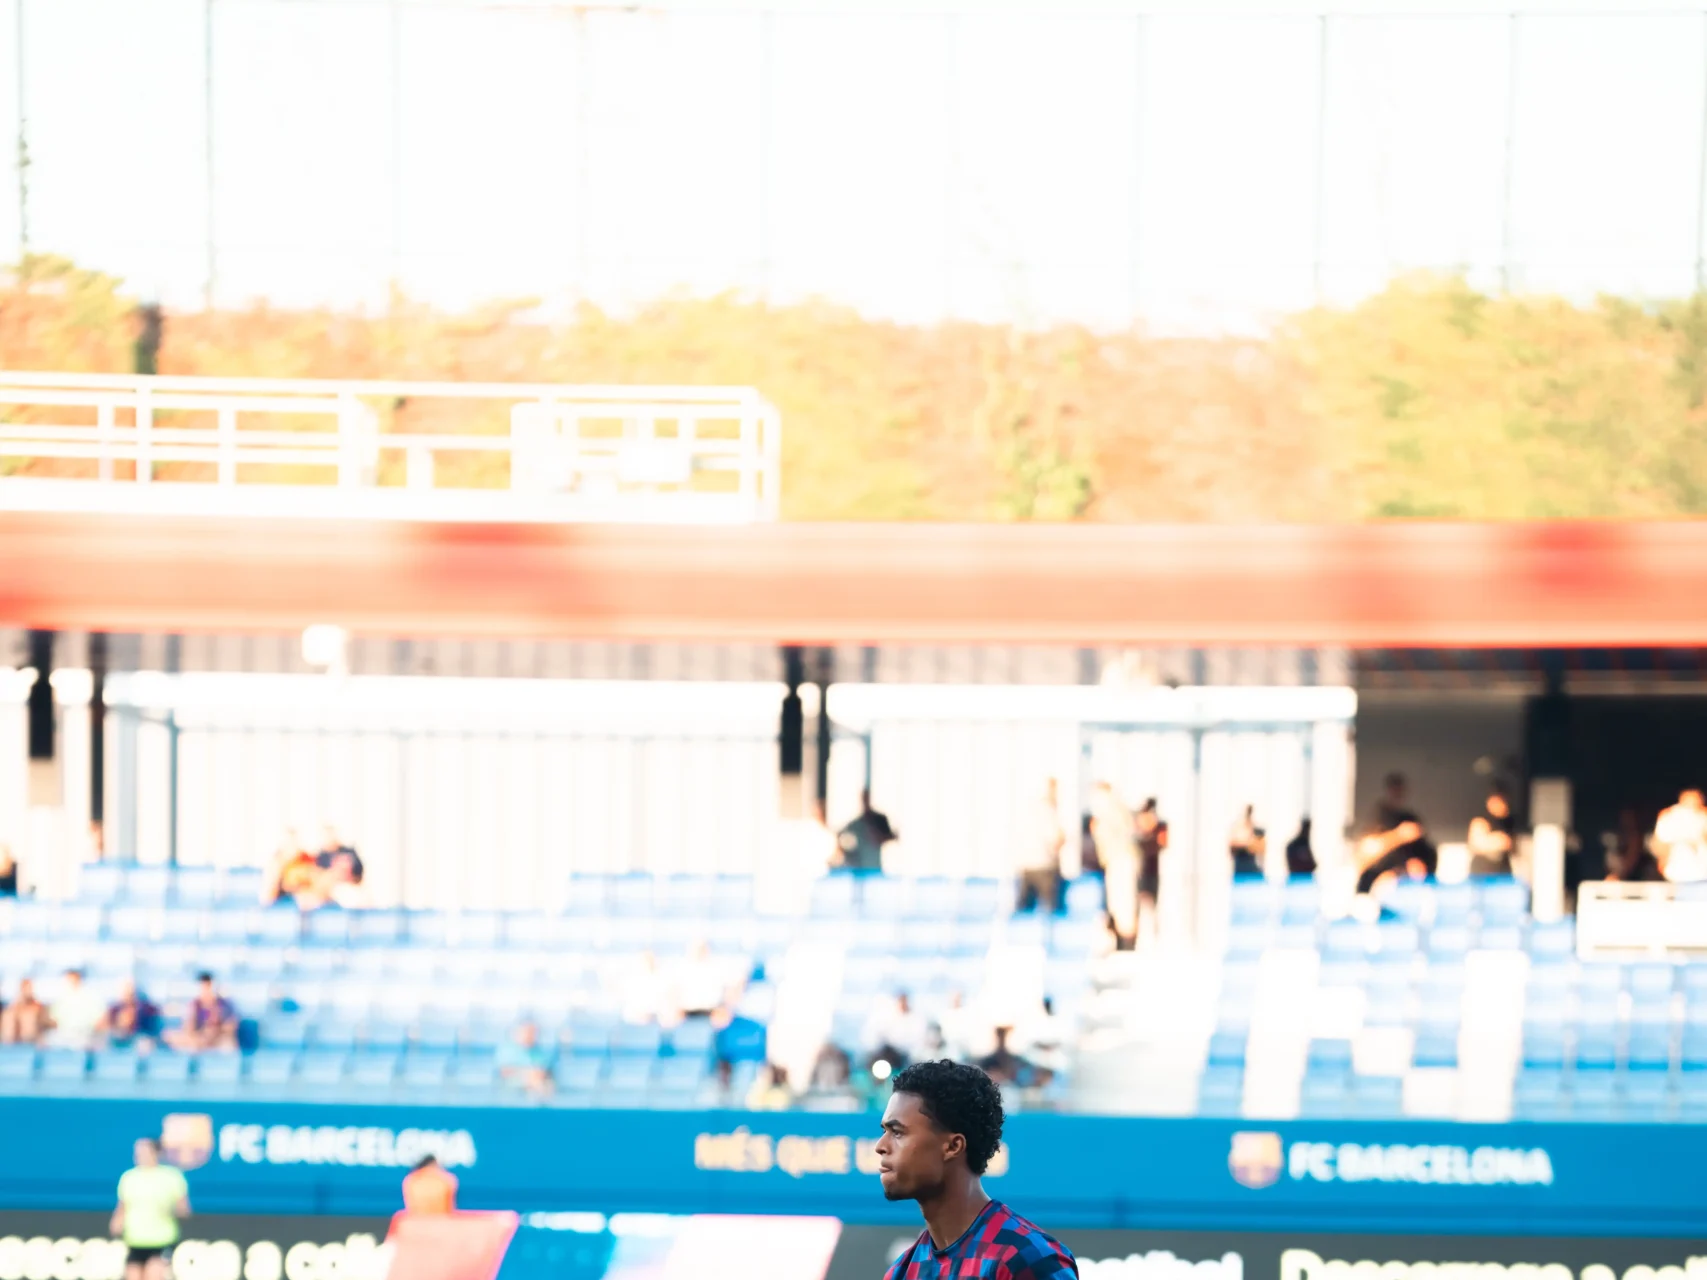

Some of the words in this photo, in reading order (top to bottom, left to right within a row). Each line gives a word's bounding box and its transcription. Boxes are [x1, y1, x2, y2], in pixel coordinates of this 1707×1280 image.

[219, 1123, 264, 1164] FC
[266, 1125, 476, 1168] BARCELONA
[1289, 1142, 1336, 1182] FC
[1337, 1143, 1554, 1186] BARCELONA
